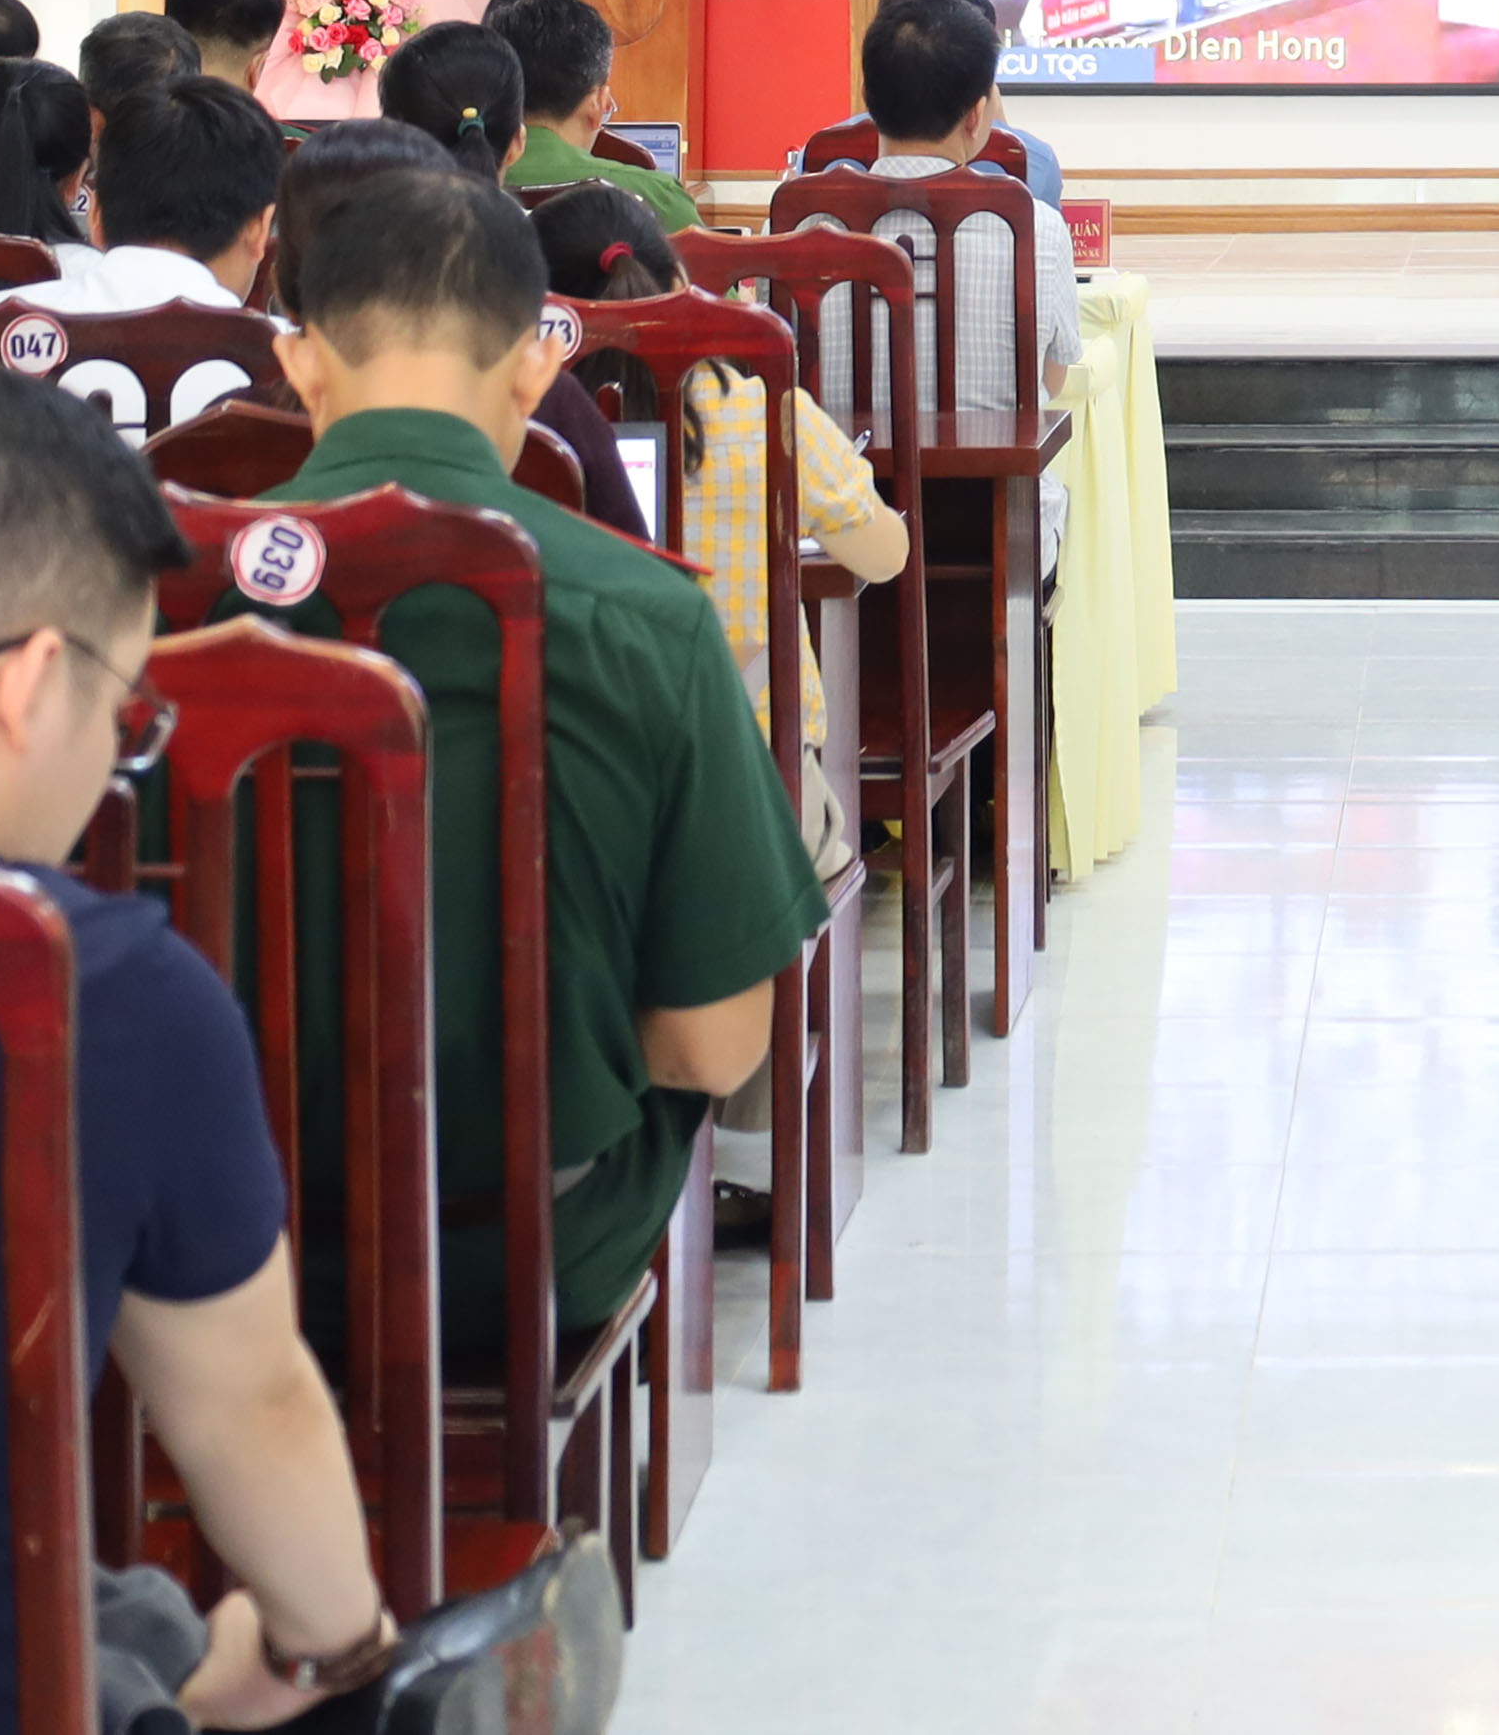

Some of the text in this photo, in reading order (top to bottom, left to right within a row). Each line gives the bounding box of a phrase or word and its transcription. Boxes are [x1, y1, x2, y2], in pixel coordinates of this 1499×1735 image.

[1163, 30, 1243, 61] Dien
[1257, 29, 1347, 70] Hong
[997, 52, 1098, 81] CU TQG
[10, 332, 58, 360] 047
[539, 319, 573, 346] 73
[253, 525, 305, 593] 039
